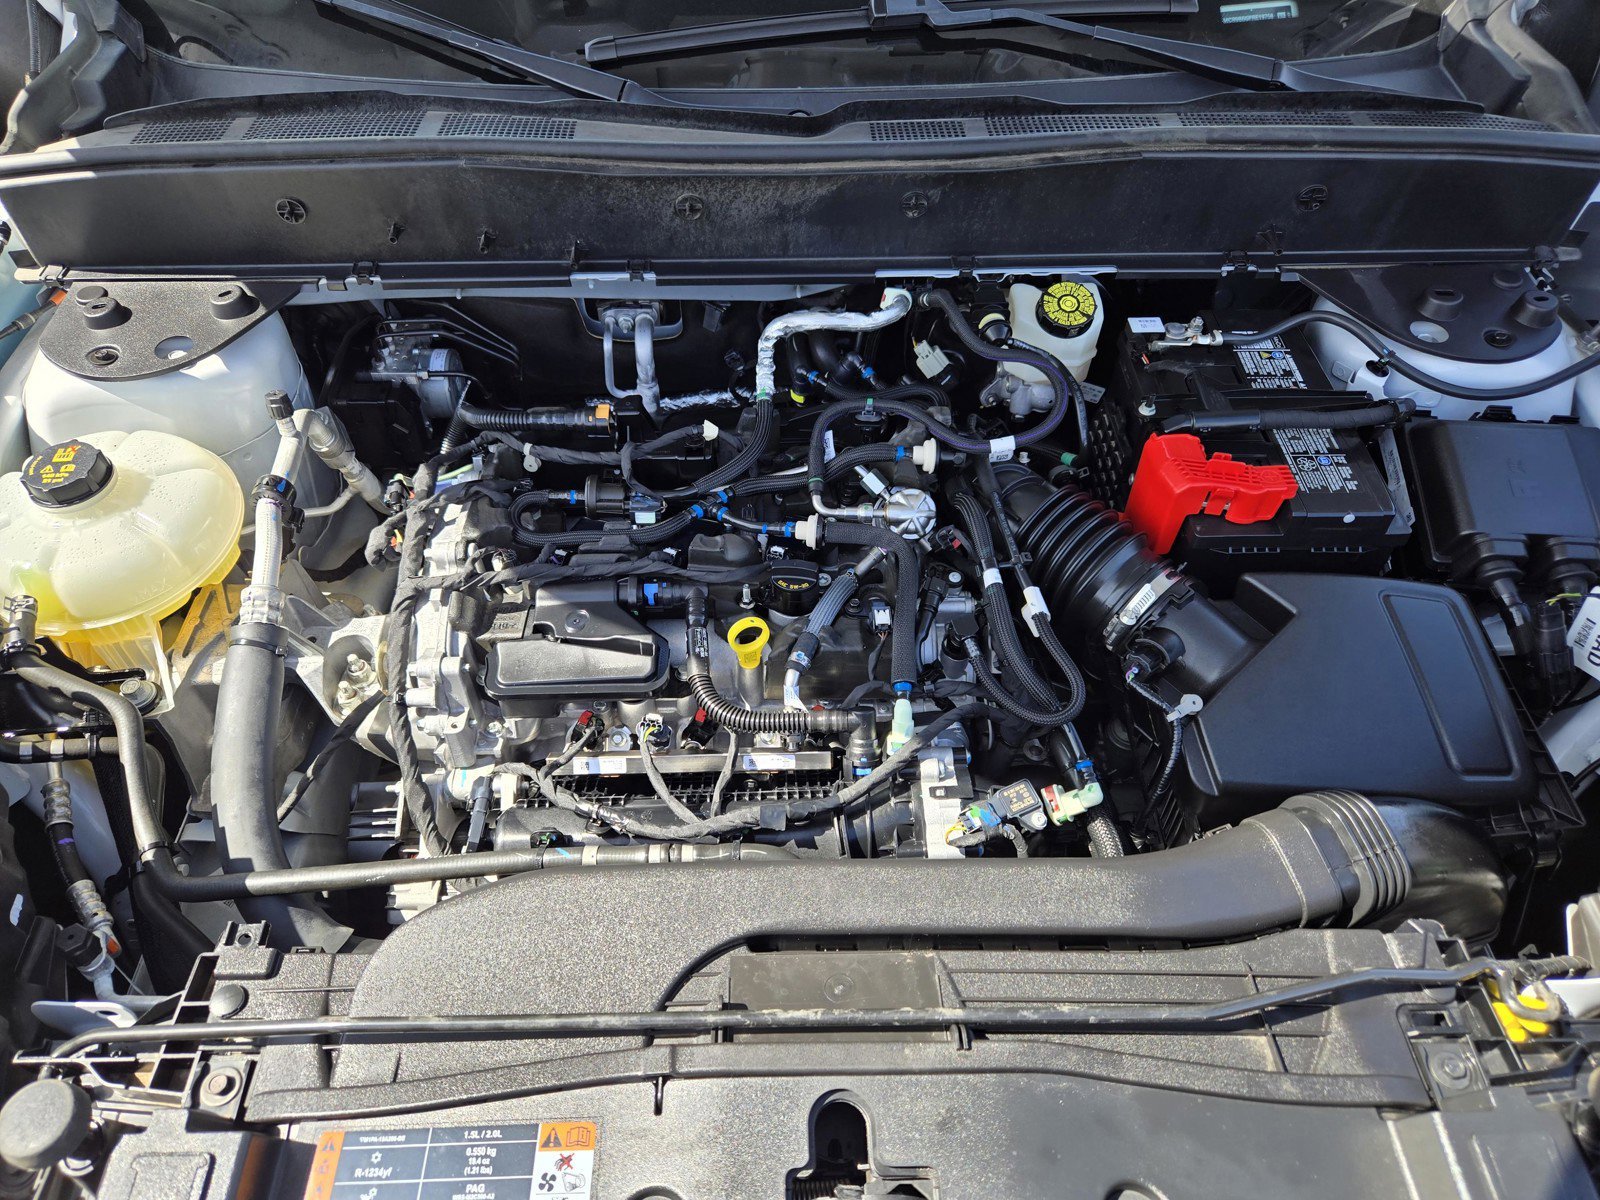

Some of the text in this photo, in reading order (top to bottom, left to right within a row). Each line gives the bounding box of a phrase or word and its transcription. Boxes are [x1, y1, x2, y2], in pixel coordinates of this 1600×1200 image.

[464, 1130, 480, 1139] 1.5L
[485, 1129, 502, 1139] 2.0L
[486, 1146, 497, 1158] kg
[354, 1167, 392, 1179] R-1234yf
[466, 1183, 485, 1194] PAG
